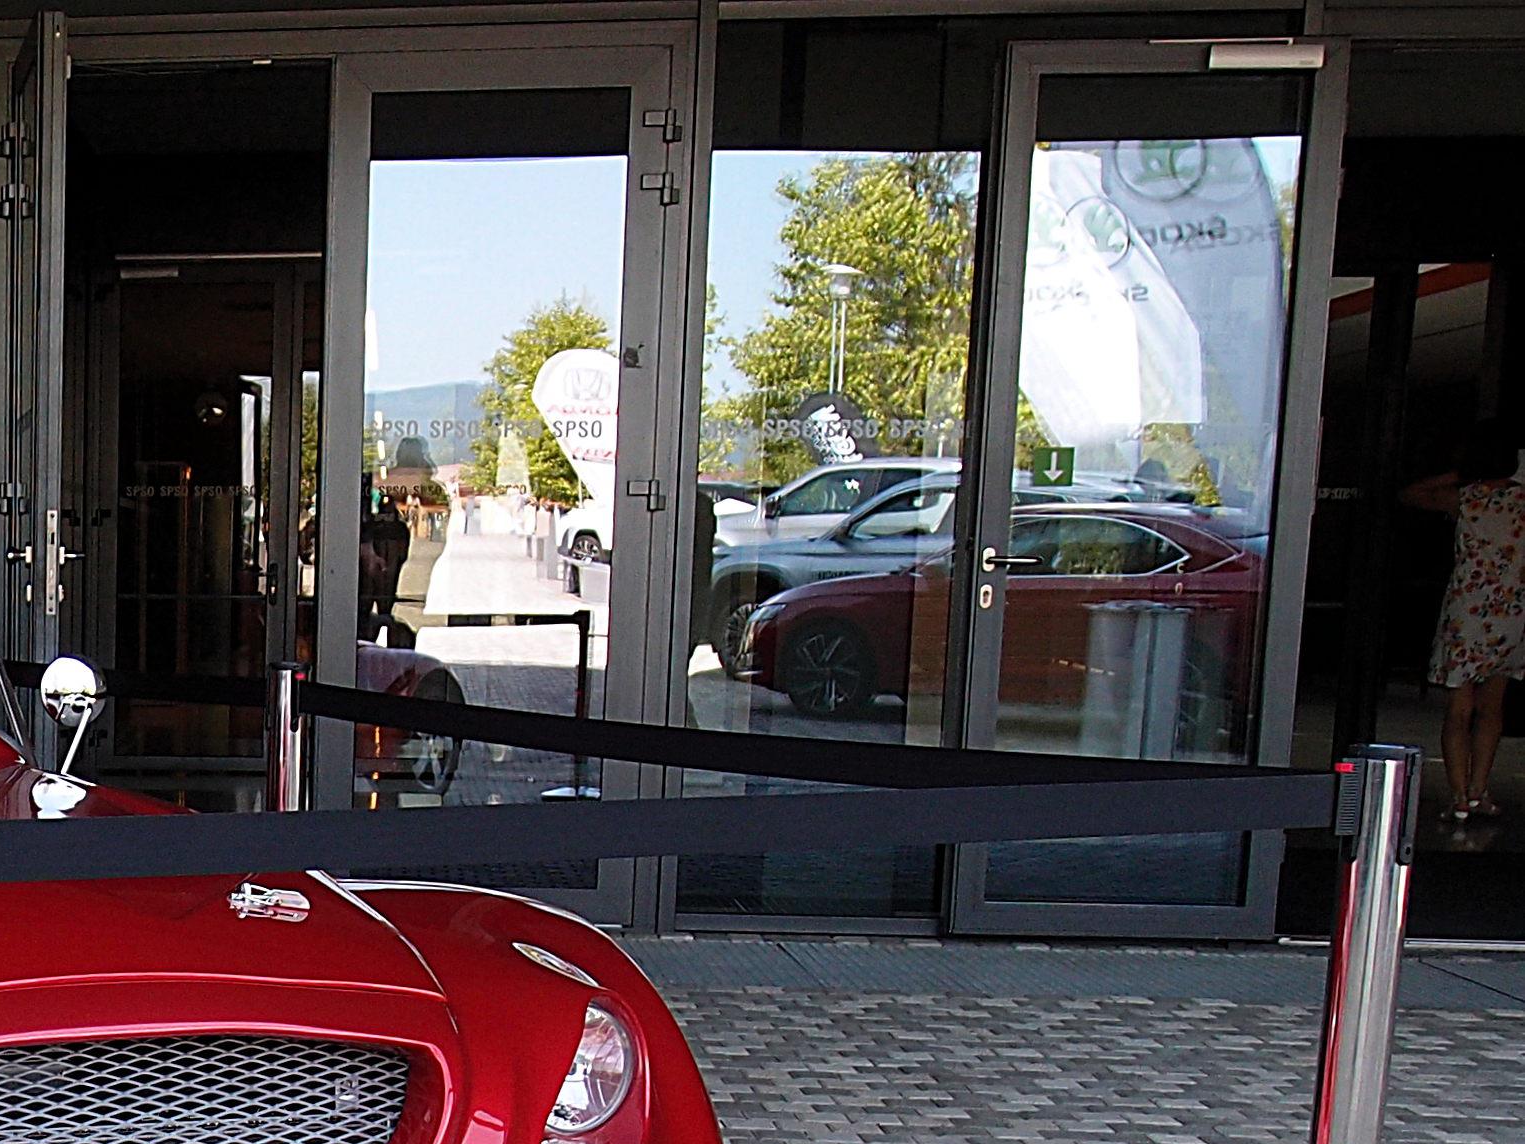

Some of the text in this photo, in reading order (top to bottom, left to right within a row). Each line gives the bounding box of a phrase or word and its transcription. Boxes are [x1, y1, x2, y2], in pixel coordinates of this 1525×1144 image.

[430, 420, 480, 438] SPSO
[552, 420, 602, 438] SPSO
[763, 419, 813, 439] SPSO
[126, 485, 155, 497] SPSO
[159, 486, 188, 497] SPSO
[194, 486, 224, 496] SPSO
